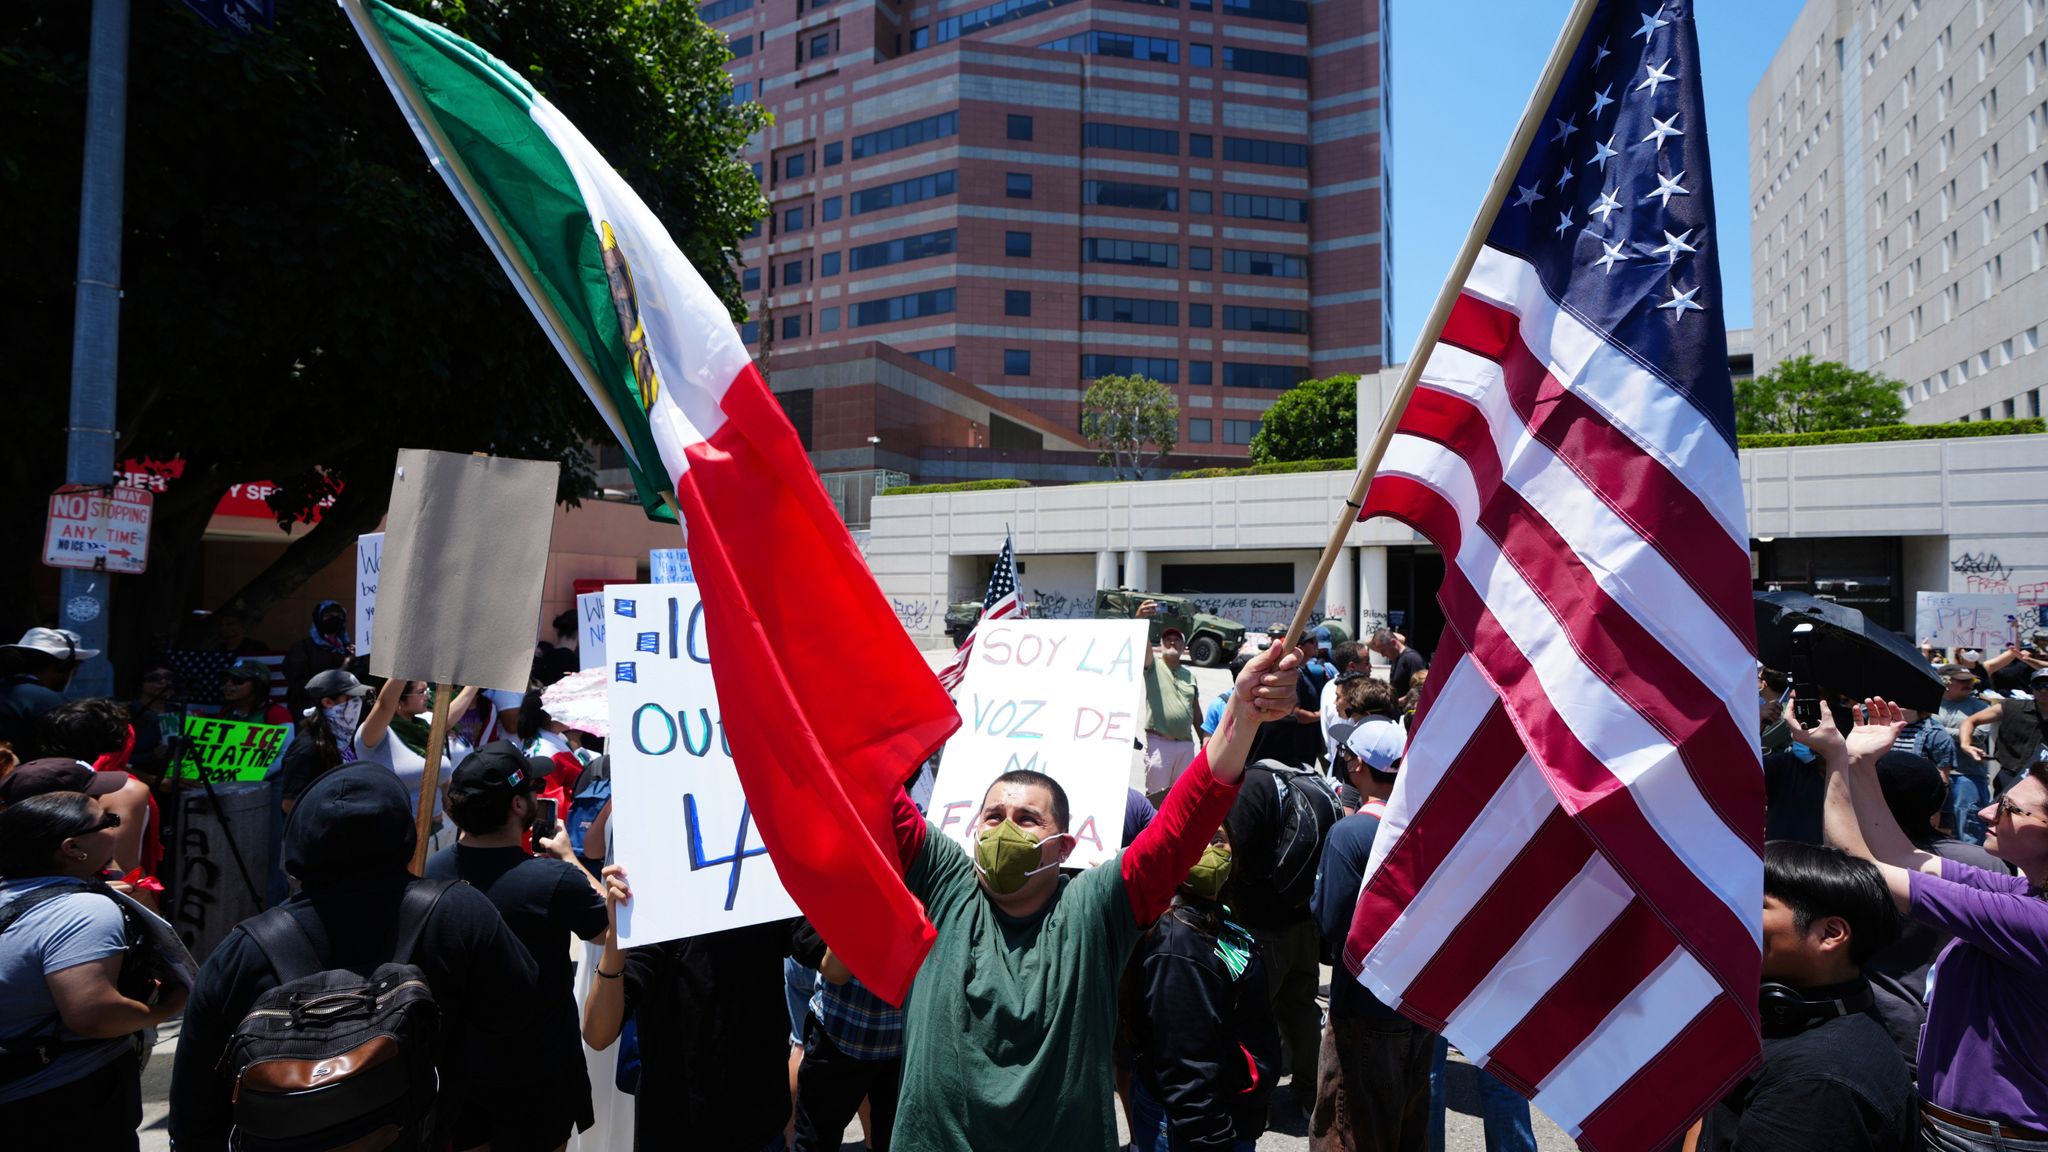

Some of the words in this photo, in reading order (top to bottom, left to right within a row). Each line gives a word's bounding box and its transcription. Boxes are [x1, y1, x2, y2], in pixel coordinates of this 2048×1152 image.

[53, 495, 87, 519] NO
[90, 502, 148, 523] STOPPING
[61, 524, 97, 540] ANY
[107, 528, 139, 545] TIME
[982, 628, 1067, 667] SOY
[1076, 636, 1133, 682] LA
[974, 693, 1047, 739] VOZ
[1073, 707, 1131, 742] DE
[186, 719, 235, 744] LET
[240, 726, 285, 750] ICE
